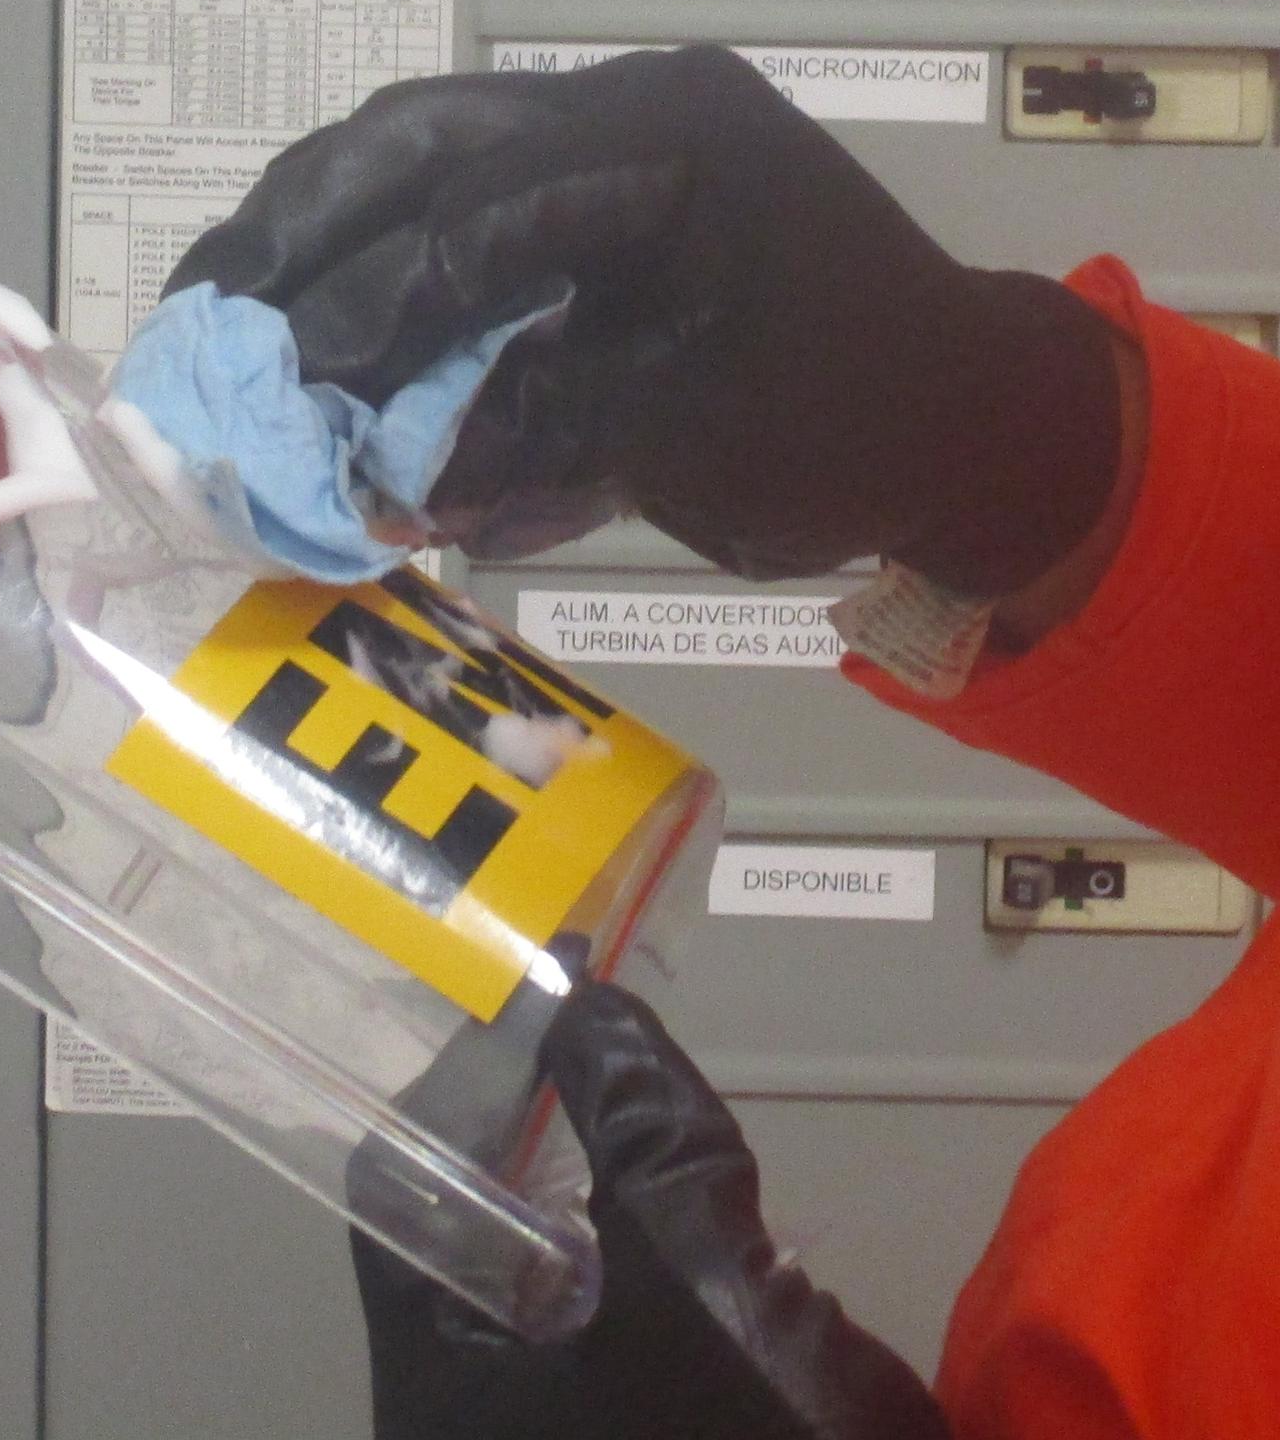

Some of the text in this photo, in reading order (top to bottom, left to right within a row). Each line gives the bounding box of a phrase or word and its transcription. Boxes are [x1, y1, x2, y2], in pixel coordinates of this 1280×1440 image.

[761, 56, 980, 82] SINCRONIZACION
[551, 601, 614, 623] ALIM.
[623, 603, 639, 624] A
[557, 630, 665, 652] TURBINA
[674, 632, 707, 654] DE
[716, 633, 768, 656] GAS
[743, 868, 893, 895] DISPONIBLE
